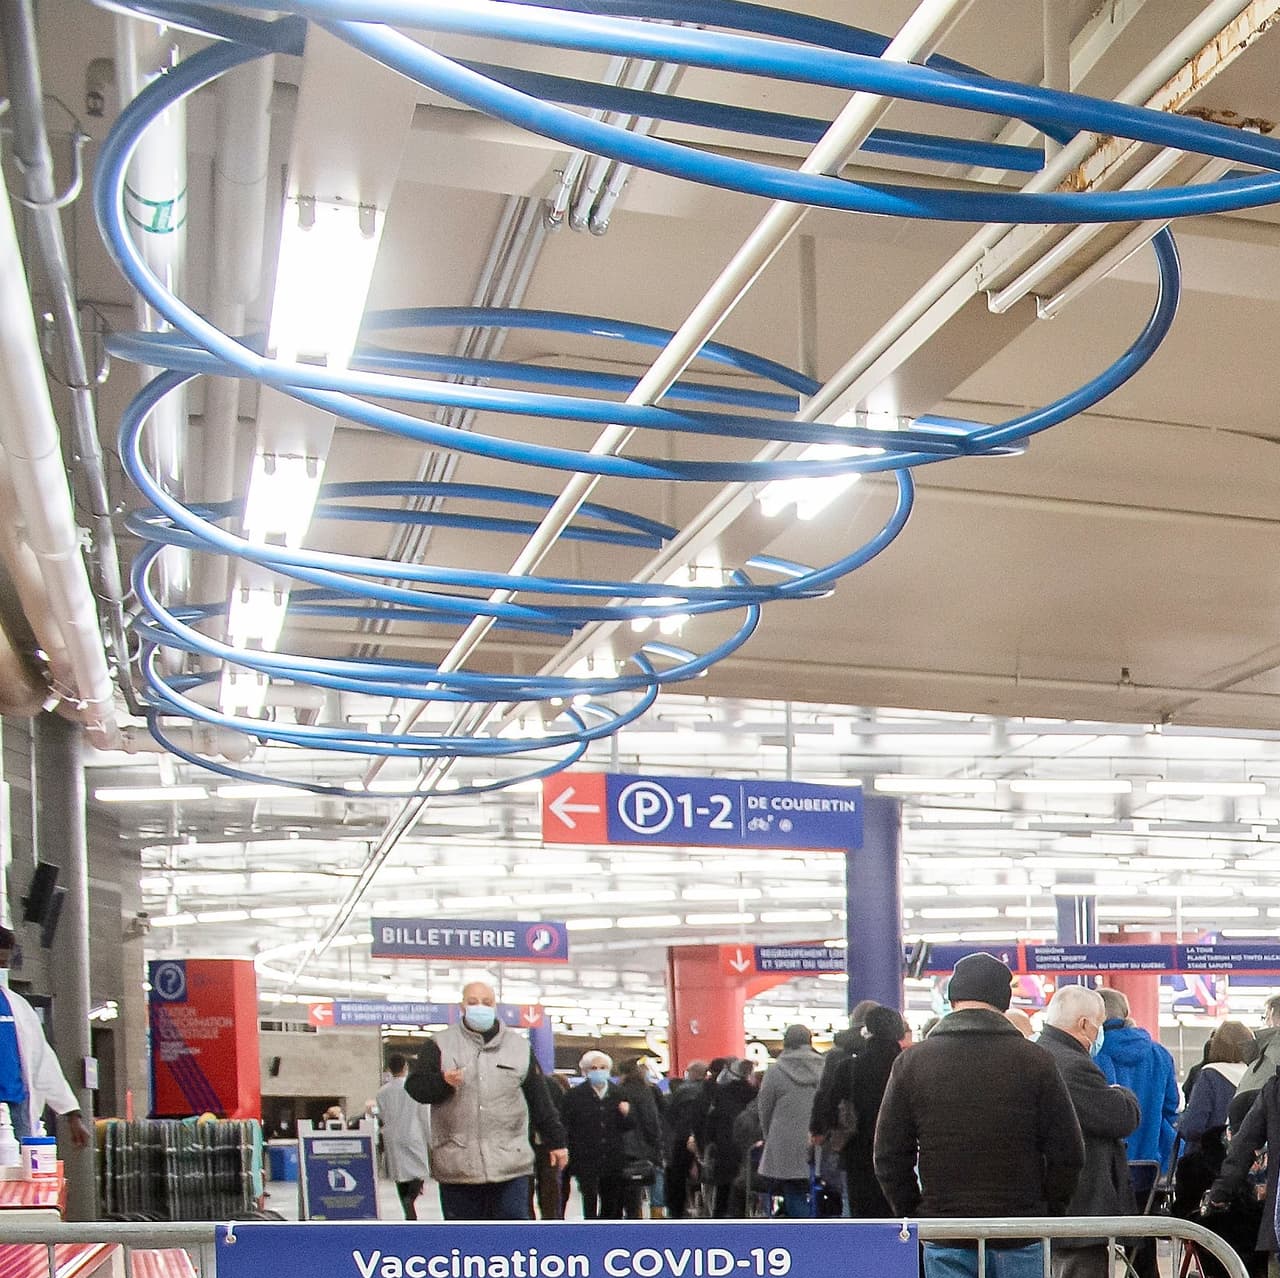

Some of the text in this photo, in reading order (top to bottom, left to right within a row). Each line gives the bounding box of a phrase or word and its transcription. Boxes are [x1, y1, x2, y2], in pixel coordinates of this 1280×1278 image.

[677, 794, 734, 829] 1-2
[748, 796, 855, 812] DE COUBERTIN
[382, 927, 515, 947] BILLETTERIE
[603, 1247, 793, 1278] COVID-19
